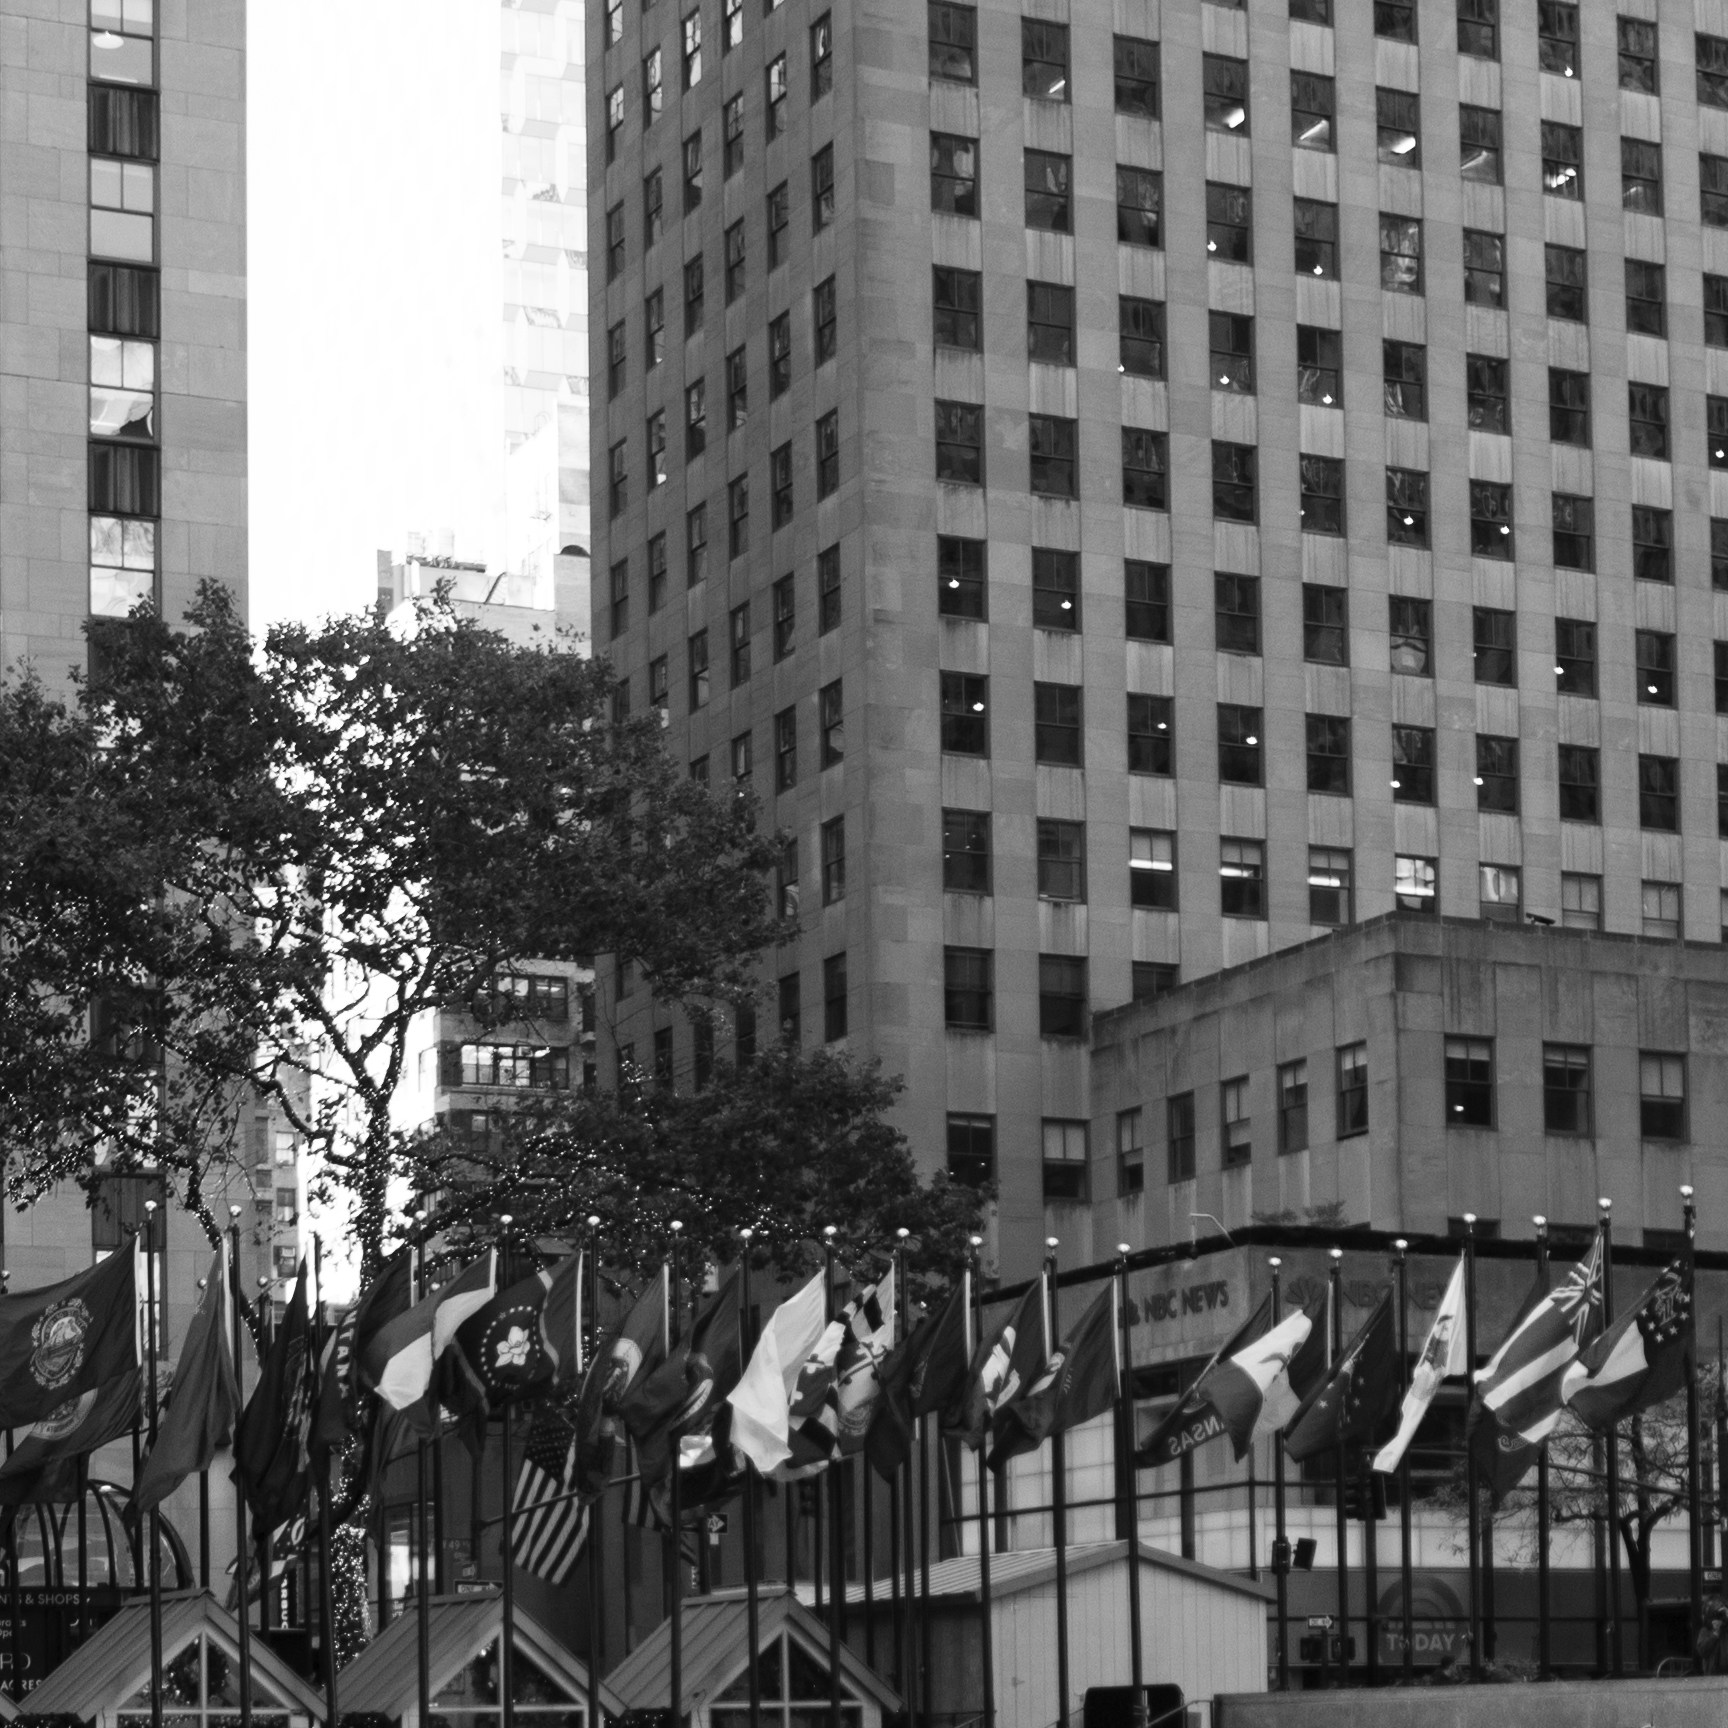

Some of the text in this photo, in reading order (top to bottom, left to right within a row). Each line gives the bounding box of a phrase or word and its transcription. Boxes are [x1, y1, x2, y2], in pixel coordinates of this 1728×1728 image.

[1144, 1280, 1229, 1323] NBC NEWS
[38, 1593, 80, 1605] SHOPS
